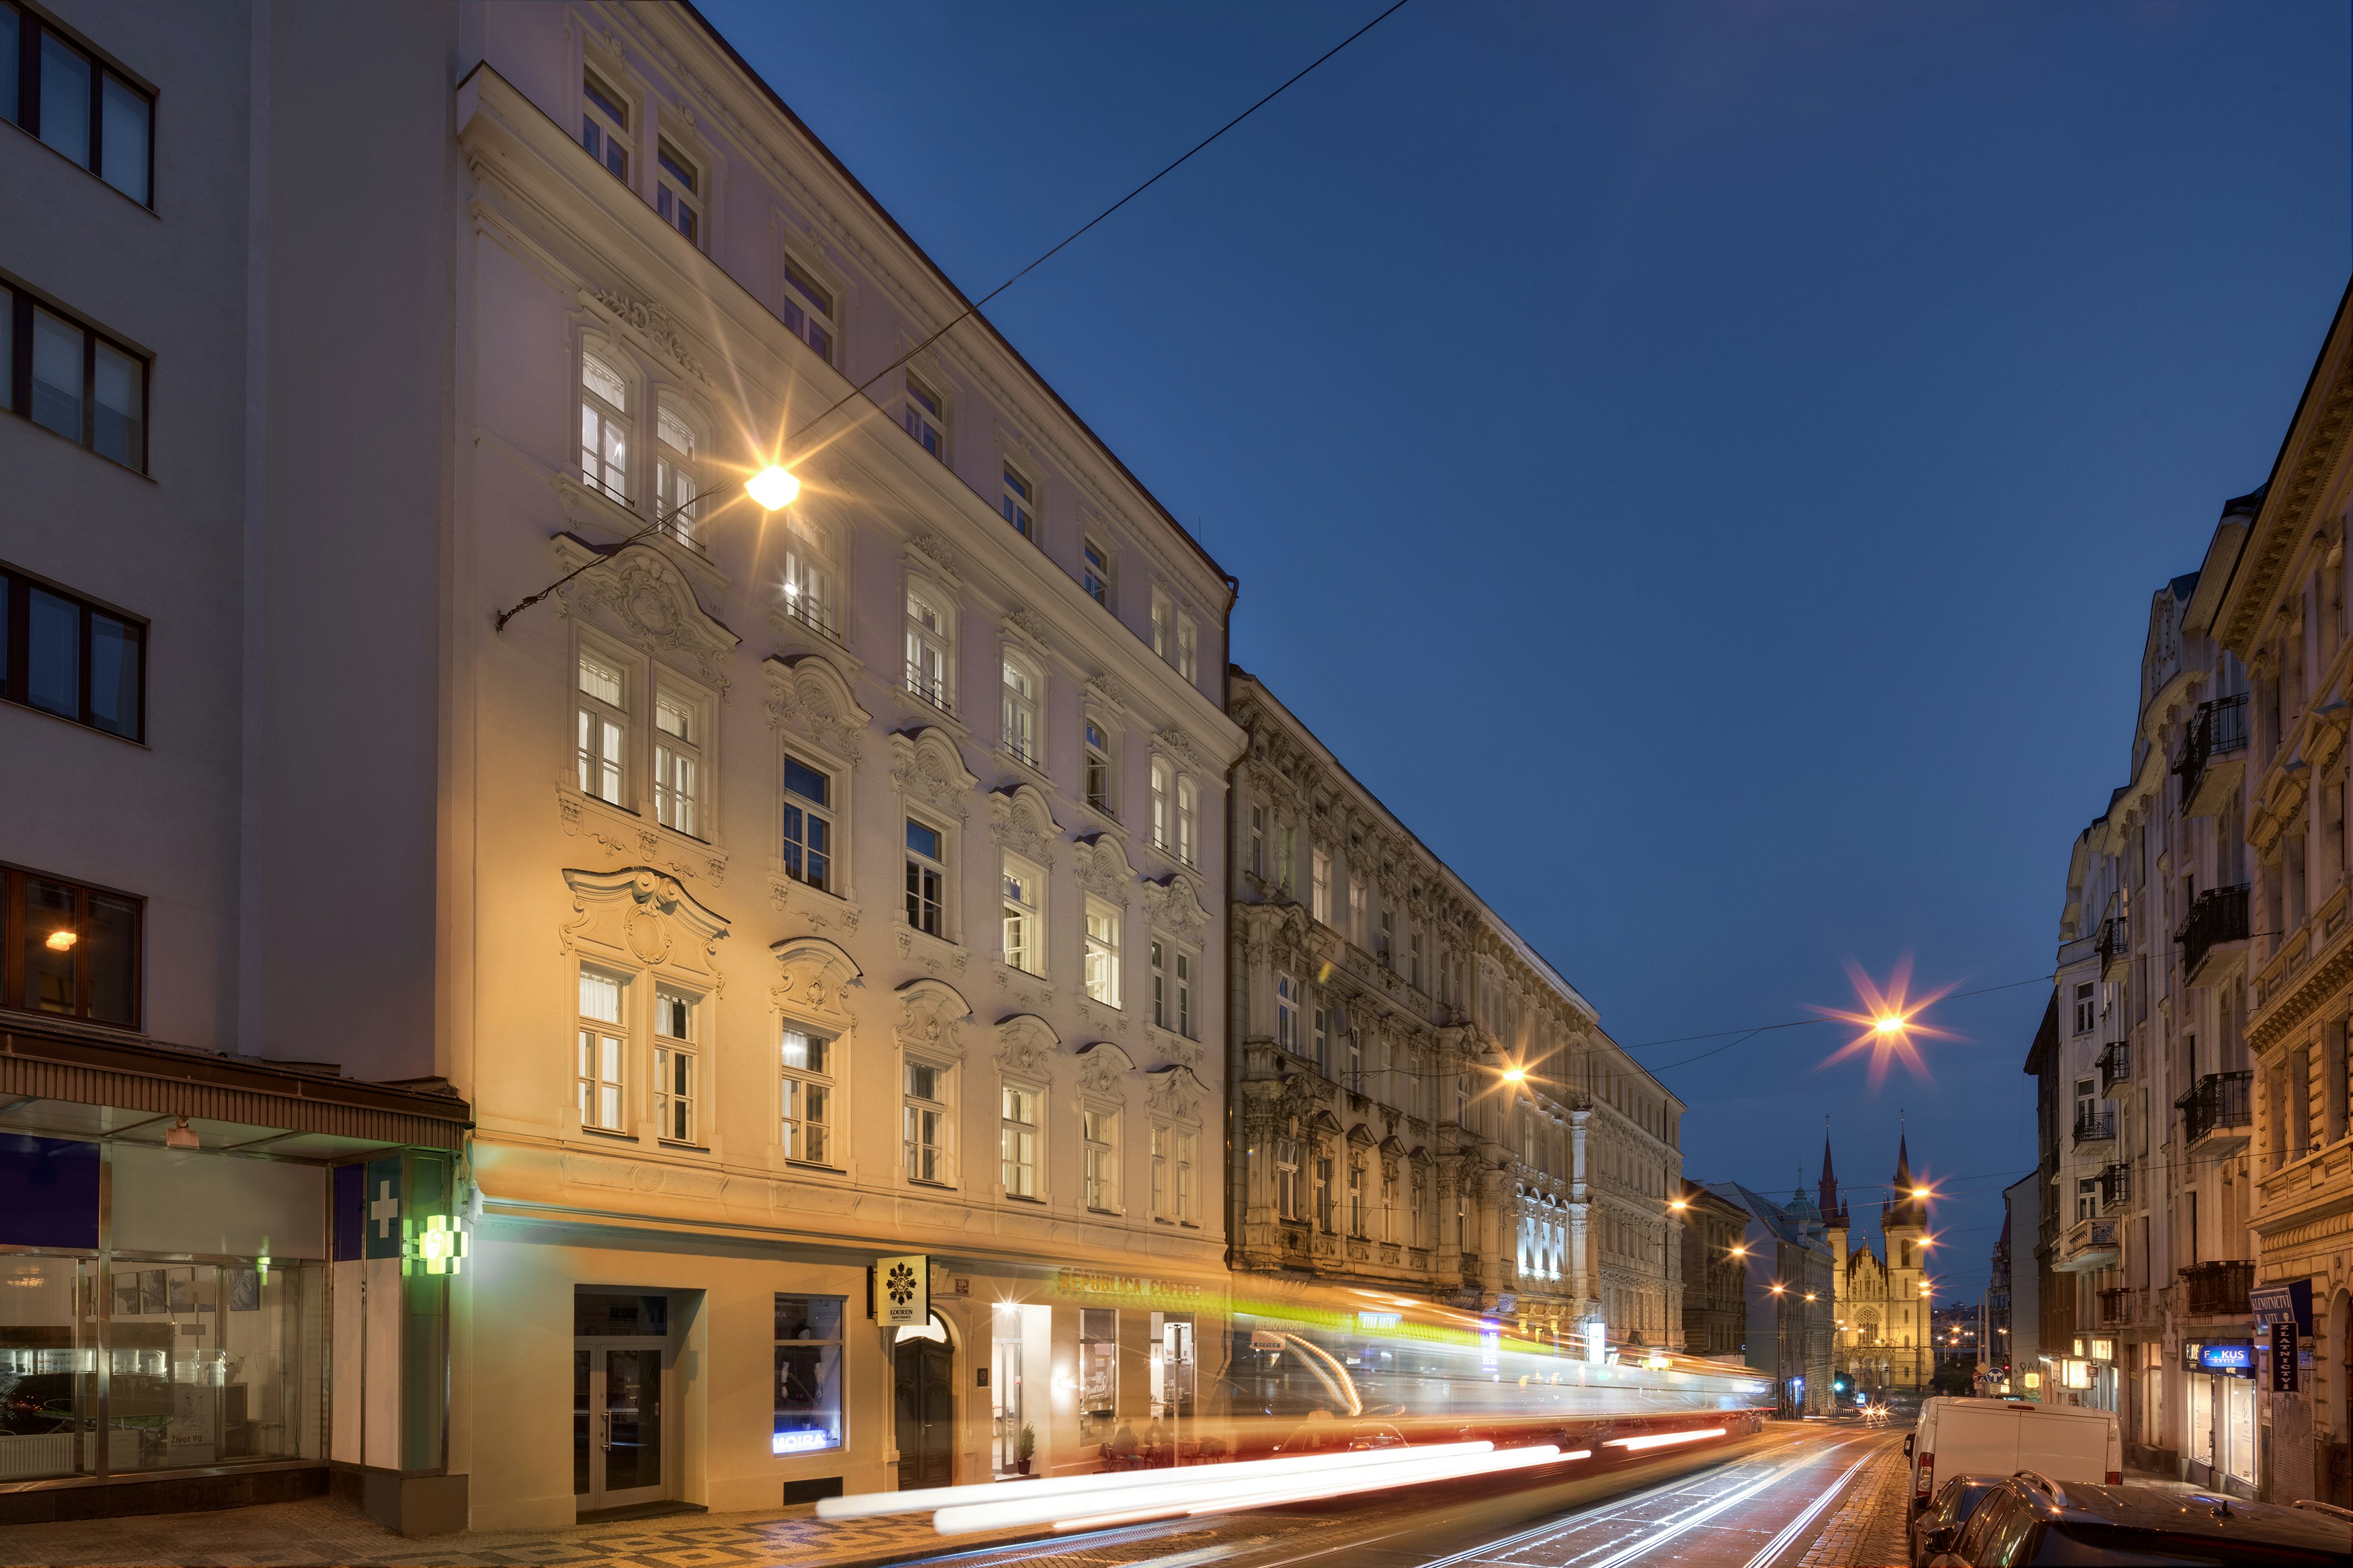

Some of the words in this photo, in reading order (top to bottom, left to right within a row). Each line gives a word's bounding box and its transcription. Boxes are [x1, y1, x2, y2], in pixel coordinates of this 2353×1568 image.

[1062, 1273, 1142, 1294] REPUBLICA
[1150, 1279, 1199, 1298] COFFEE
[1254, 1319, 1304, 1330] NEMOVITOSTI
[171, 1434, 190, 1443] Život
